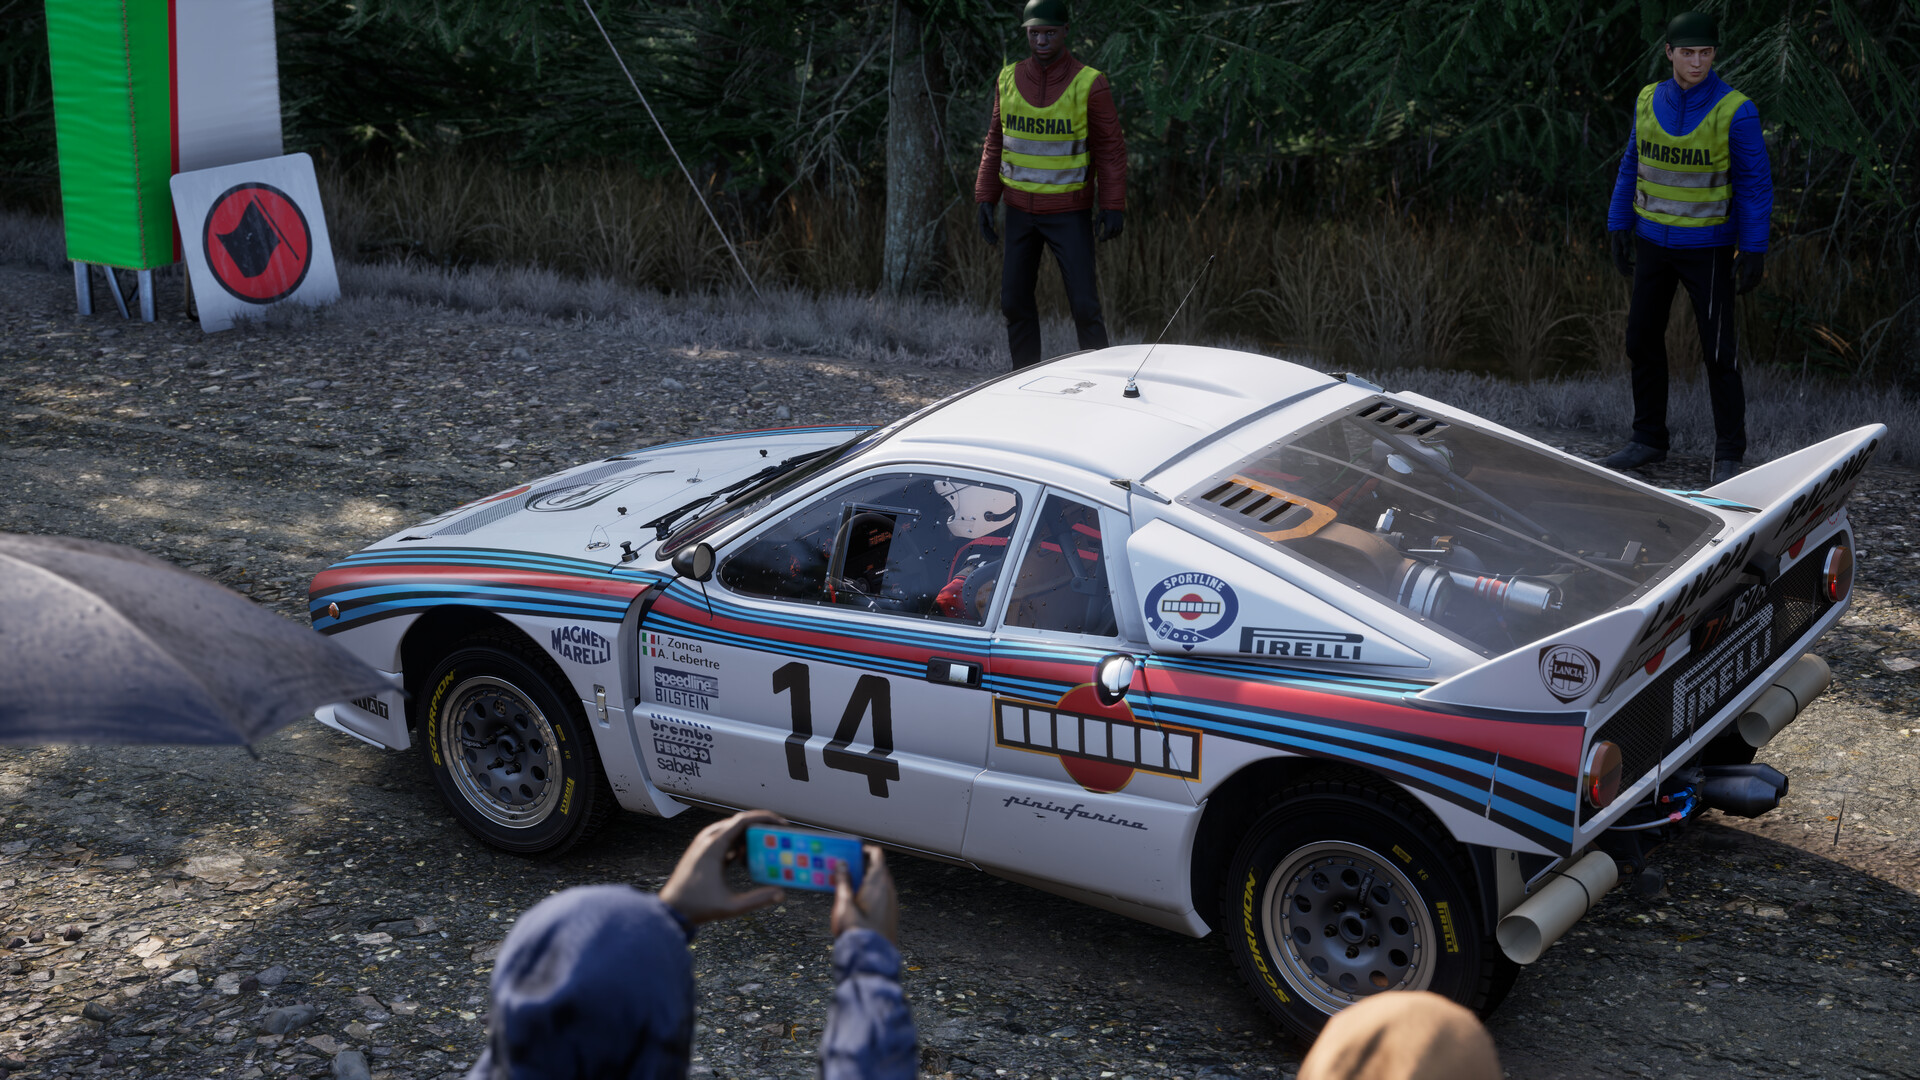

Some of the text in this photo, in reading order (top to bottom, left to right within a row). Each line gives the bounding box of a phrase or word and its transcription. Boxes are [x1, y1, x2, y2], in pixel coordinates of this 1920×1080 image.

[1006, 114, 1074, 135] MARSHAL
[1641, 139, 1713, 166] MARSHAL
[1773, 438, 1878, 540] RACING
[1163, 573, 1225, 593] SPORTLINE
[1638, 531, 1755, 646] LANCIA
[551, 625, 611, 654] MAGNETI
[551, 636, 611, 665] MARELLI
[657, 635, 702, 654] I. Zonca
[1239, 626, 1364, 661] PIRELLI
[657, 648, 720, 670] A. Lebertre
[1554, 663, 1584, 678] LANCIA
[1672, 602, 1774, 739] PIRELLI
[655, 671, 712, 692] speedline
[655, 687, 709, 711] BILSTEIN
[428, 670, 455, 767] SCORPION
[650, 719, 713, 742] brembo
[773, 661, 900, 798] 14
[656, 741, 709, 762] FERODO
[657, 757, 702, 778] sabelt
[560, 777, 575, 815] PIRELLI
[1002, 795, 1148, 831] pininfarina
[1243, 870, 1290, 1004] SCORPION
[1436, 901, 1458, 953] PIRELLI
